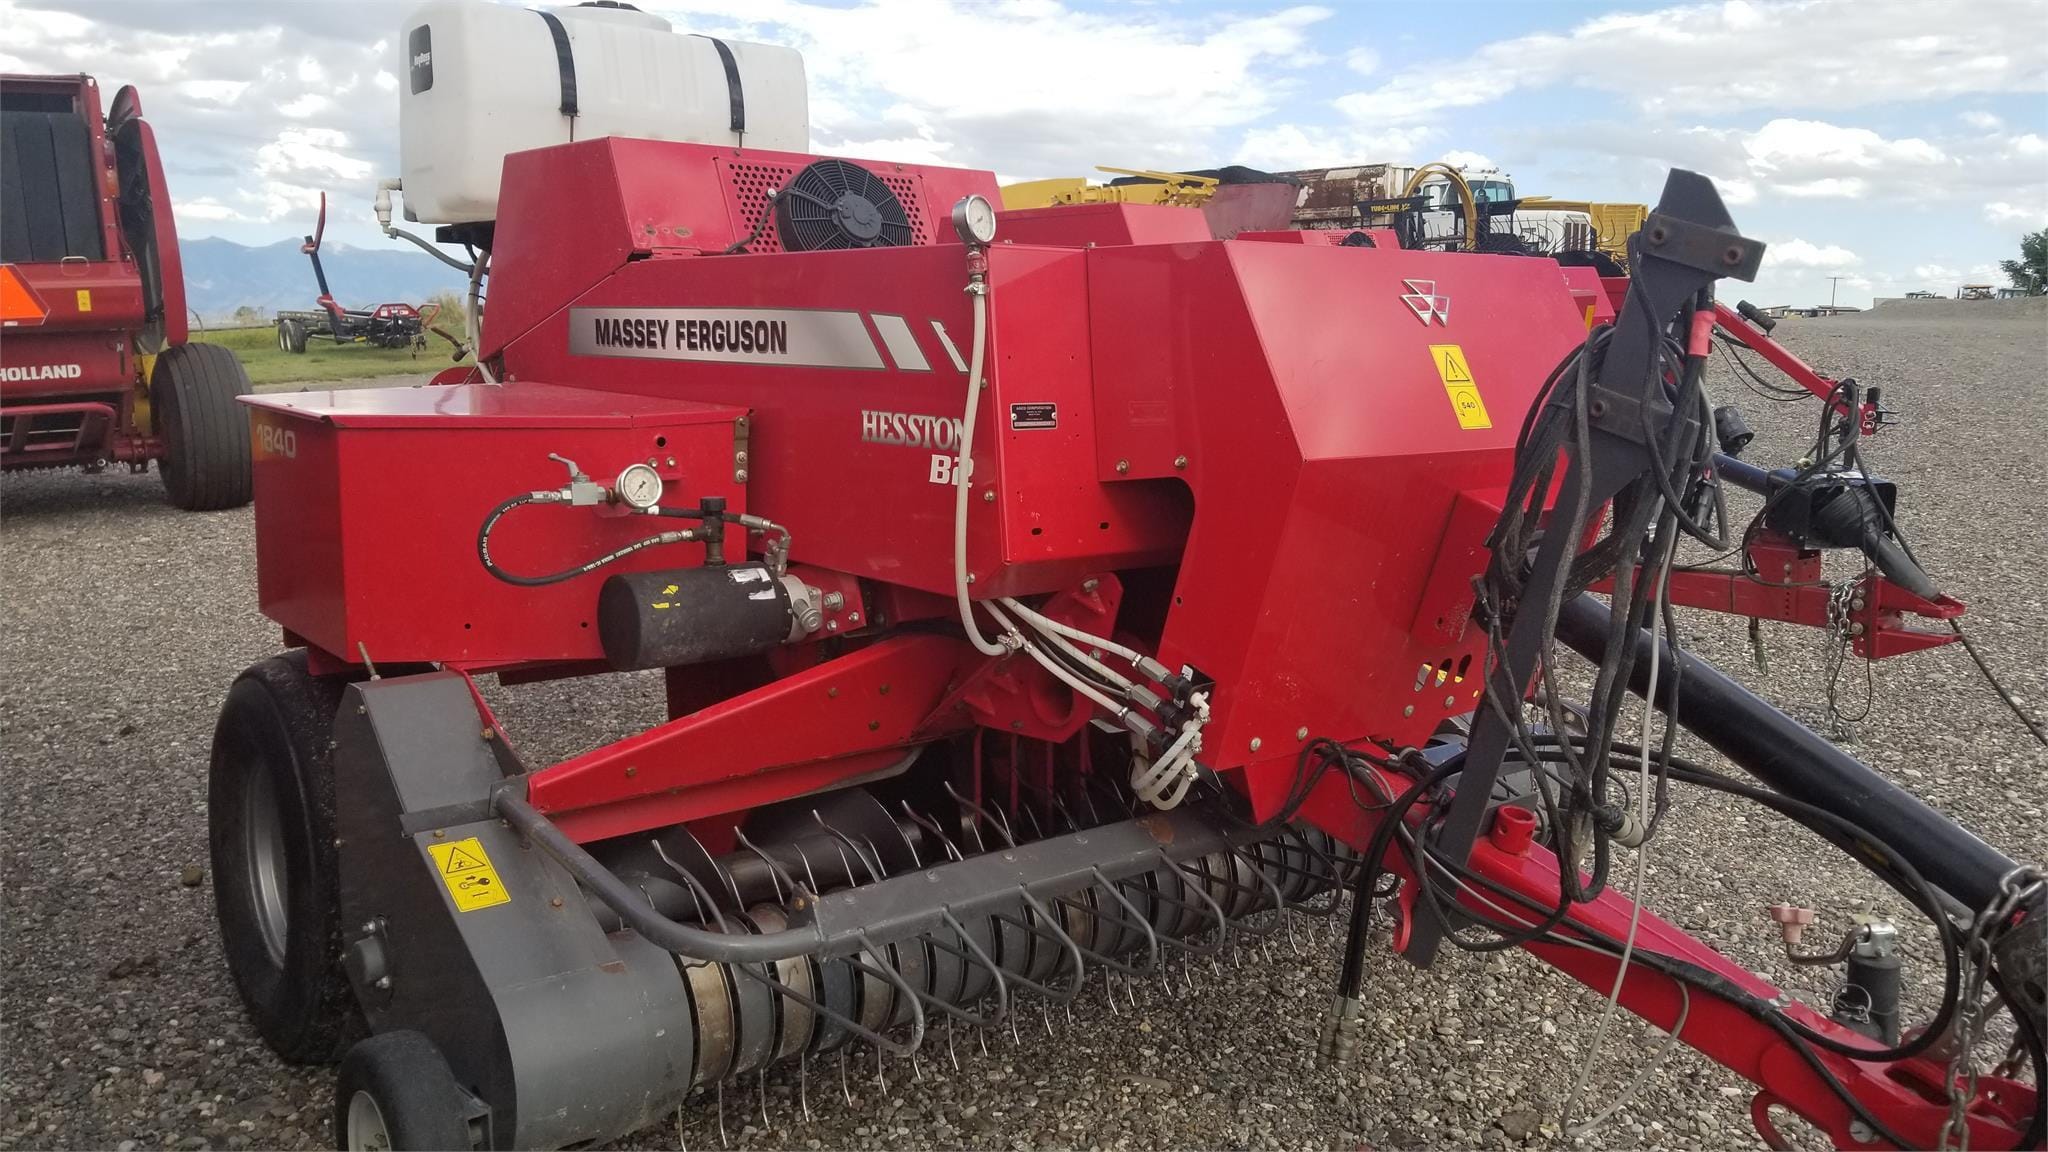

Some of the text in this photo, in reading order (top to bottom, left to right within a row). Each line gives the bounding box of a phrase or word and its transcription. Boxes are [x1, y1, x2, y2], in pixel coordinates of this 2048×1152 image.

[595, 318, 787, 354] MASSEY FERGUSON
[256, 424, 296, 458] 1840
